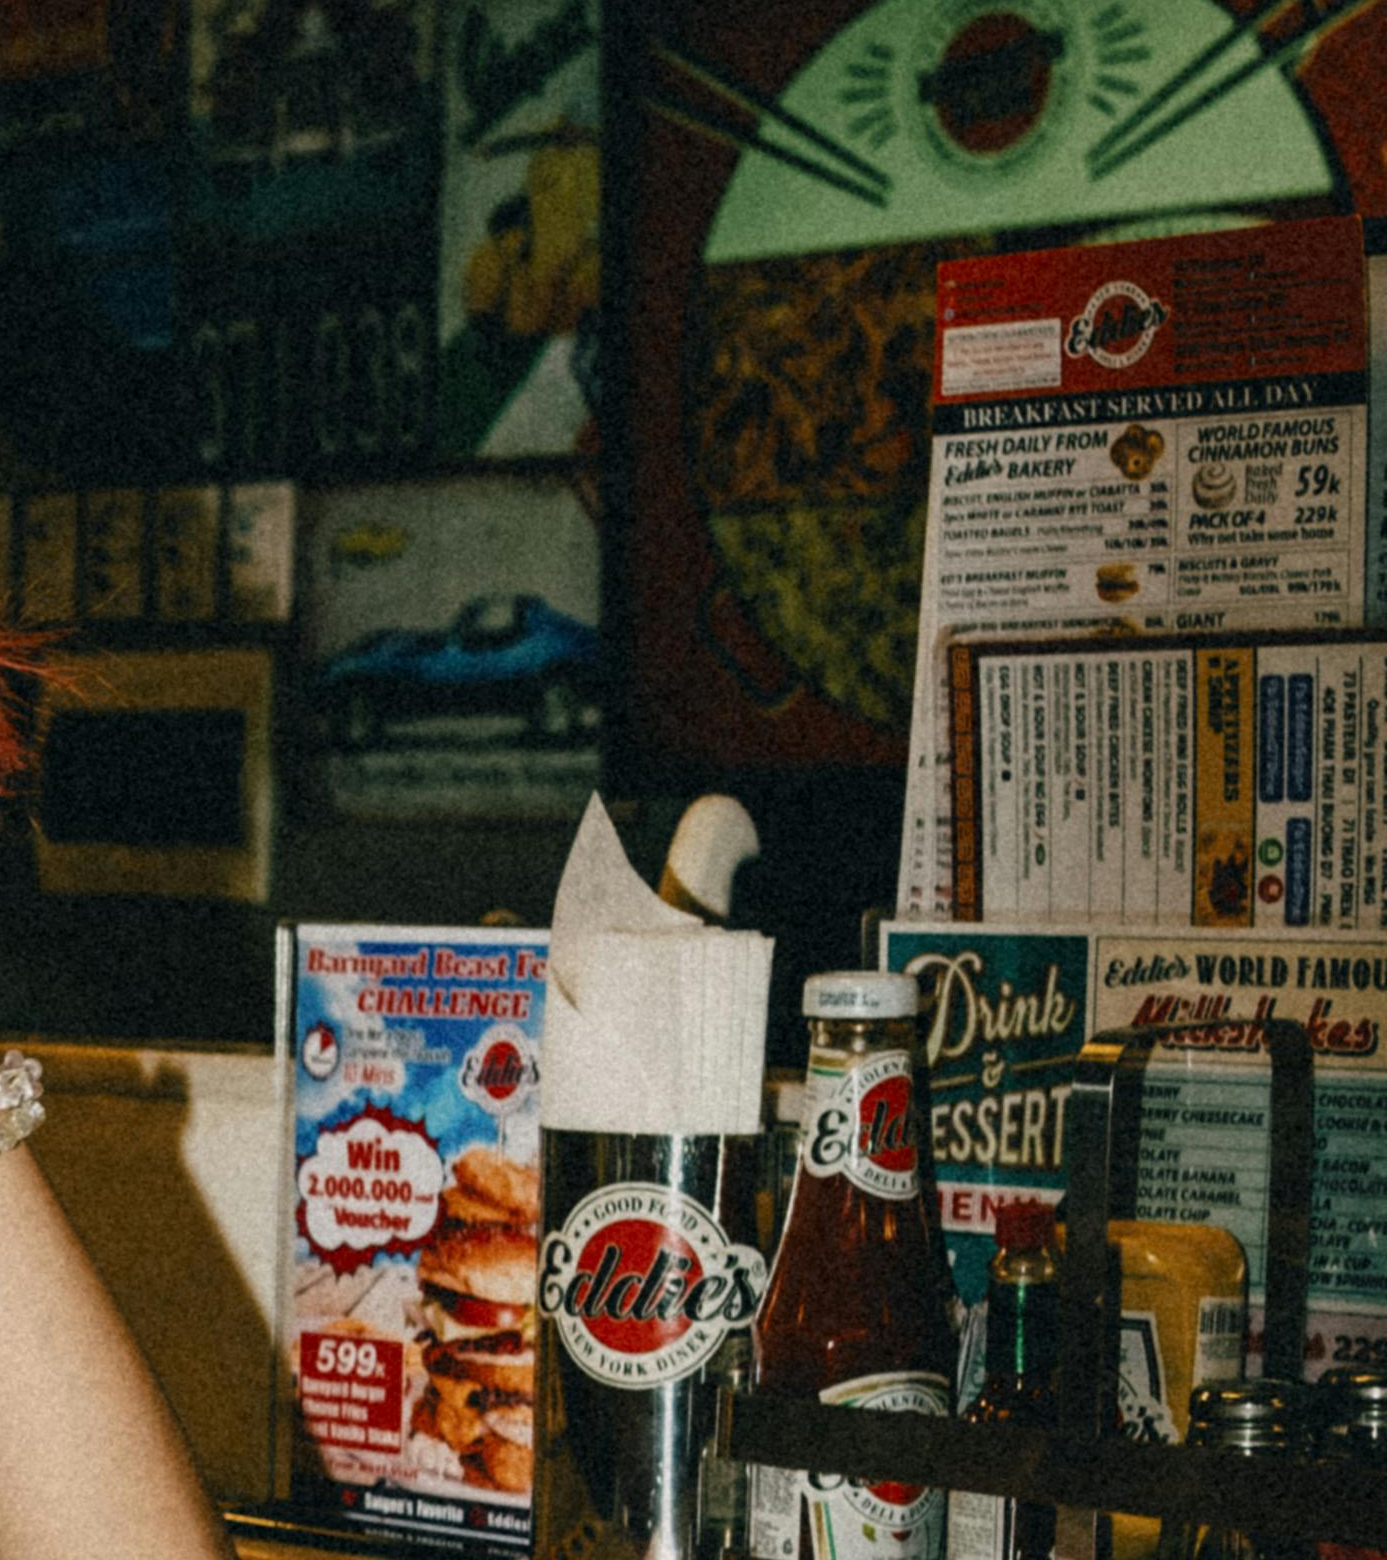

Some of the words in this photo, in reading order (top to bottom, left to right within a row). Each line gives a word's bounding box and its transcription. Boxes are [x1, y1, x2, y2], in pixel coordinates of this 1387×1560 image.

[963, 400, 1100, 428] BREAKFAST
[1108, 391, 1203, 417] SERVED
[1210, 387, 1258, 409] ALL
[1265, 382, 1317, 404] DAY
[944, 438, 999, 459] FRESH
[1002, 433, 1052, 456] DAILY
[1055, 429, 1108, 452] FROM
[1197, 423, 1261, 443] WORLD
[1262, 417, 1335, 437] FAMOUS
[1187, 441, 1287, 464] CINNAMON
[1291, 438, 1339, 457] BUNS
[1006, 458, 1077, 481] BAKERY
[1295, 464, 1340, 498] 59k
[986, 490, 1031, 504] ENGLISH
[1089, 482, 1140, 497] CIABATTA
[1091, 500, 1125, 514] TOAST
[1244, 491, 1278, 506] Daily
[1188, 511, 1231, 530] PACK
[1232, 510, 1254, 527] OF
[1256, 510, 1267, 526] 4
[1294, 506, 1338, 525] 229k
[1187, 532, 1215, 546] Why
[1267, 530, 1298, 540] some
[1301, 526, 1334, 539] home
[965, 570, 1023, 583] BREAKFAST
[1176, 612, 1225, 629] GIANT
[1033, 705, 1045, 740] SOUR
[1075, 704, 1086, 739] SOUR
[1140, 707, 1153, 755] CHEESE
[1222, 657, 1240, 803] APPETIZERS
[1342, 692, 1356, 762] PASTEUR
[1000, 731, 1012, 764] SOUP
[1322, 718, 1335, 759] PHAM
[1034, 743, 1045, 779] SOUP
[1075, 743, 1086, 778] SOUP
[1175, 793, 1187, 834] ROLLS
[1341, 837, 1355, 878] THAO
[307, 947, 426, 981] Barnyard
[434, 949, 508, 979] Beast
[1104, 953, 1191, 987] Eddie's
[1195, 954, 1288, 987] WORLD
[357, 988, 530, 1019] CHALLENGE
[904, 950, 1075, 1068] Drink
[1131, 994, 1378, 1055] Milkshkes
[463, 1052, 542, 1088] Eddie's
[981, 1049, 1005, 1088] &
[931, 1083, 1072, 1167] ESSERT
[1181, 1111, 1264, 1127] CHEESECAKE
[347, 1137, 400, 1172] Win
[307, 1173, 412, 1203] 2.000.000
[1181, 1170, 1236, 1184] BANANA
[593, 1196, 643, 1220] GOOD
[1181, 1189, 1241, 1205] CARAMEL
[333, 1206, 412, 1232] Voucher
[1180, 1208, 1210, 1221] CHIP
[539, 1238, 761, 1322] Eddie's
[568, 1322, 594, 1356] NEW
[599, 1354, 648, 1376] YORK
[655, 1328, 709, 1371] DINER
[862, 1498, 894, 1521] DELI
